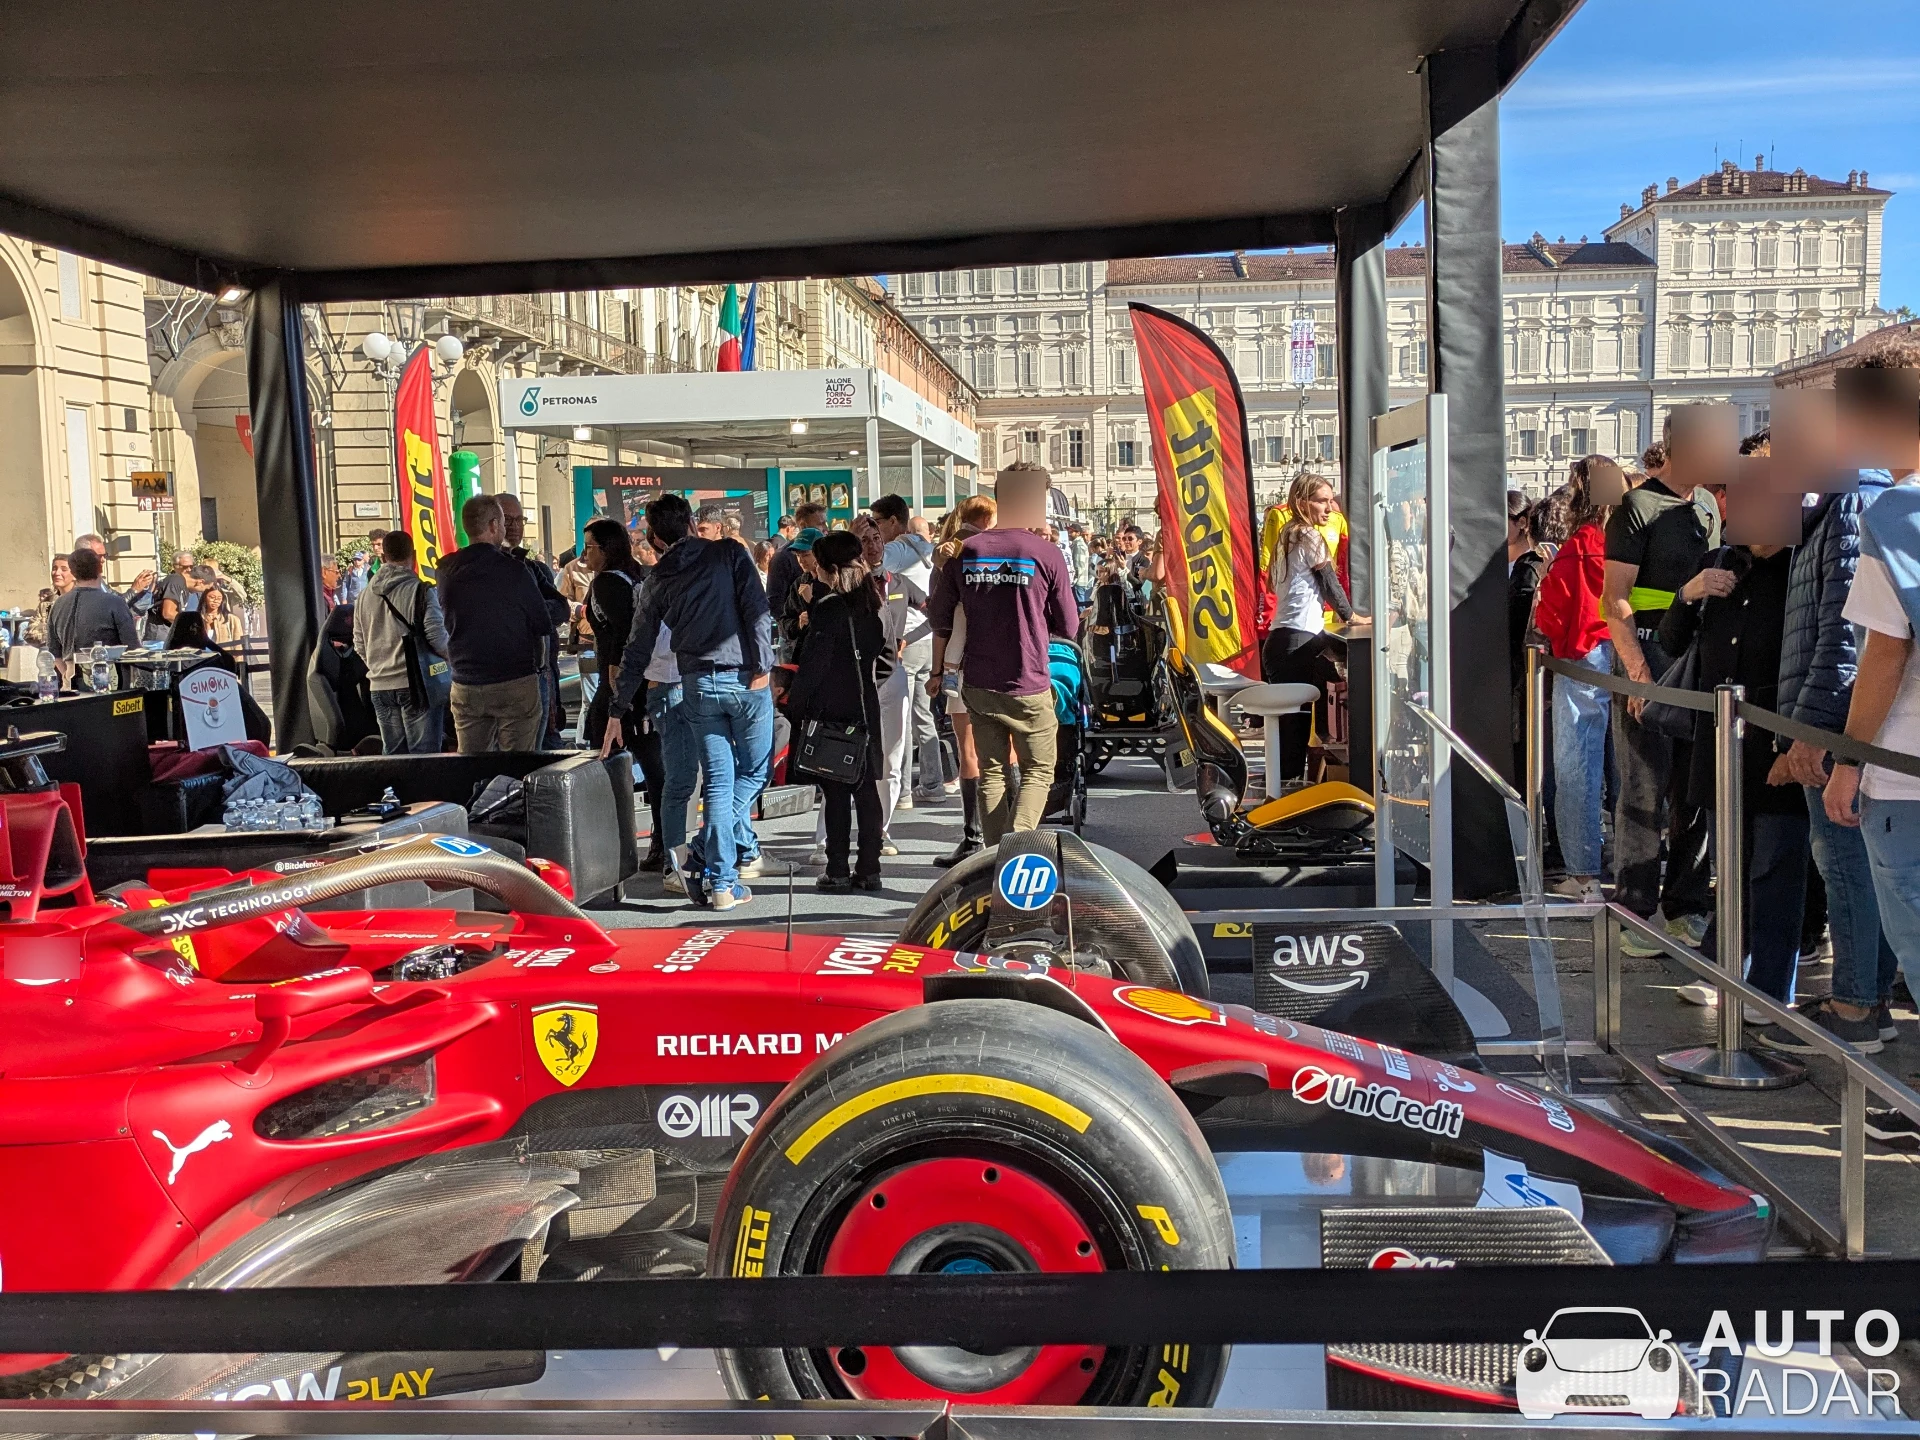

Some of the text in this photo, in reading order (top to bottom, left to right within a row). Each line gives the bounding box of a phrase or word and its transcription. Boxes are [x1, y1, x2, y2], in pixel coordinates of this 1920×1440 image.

[542, 396, 598, 405] PETRONAS
[133, 478, 166, 493] TAXI
[612, 477, 661, 486] PLAYER 1
[965, 572, 1029, 585] patagonia
[190, 676, 229, 694] GIMOKA
[115, 700, 141, 714] Sabelt
[284, 860, 325, 870] Bitdefender
[1008, 855, 1050, 909] hp
[160, 884, 313, 934] DXC TECHNOLOGY
[664, 929, 735, 964] GENESYS
[1272, 935, 1365, 967] aws
[816, 937, 925, 975] VGW PLAY
[657, 1033, 851, 1056] RICHARD M
[902, 1111, 916, 1120] FOR
[981, 1106, 996, 1115] USE
[999, 1109, 1018, 1120] ONLY
[1329, 1076, 1464, 1137] UniCredit
